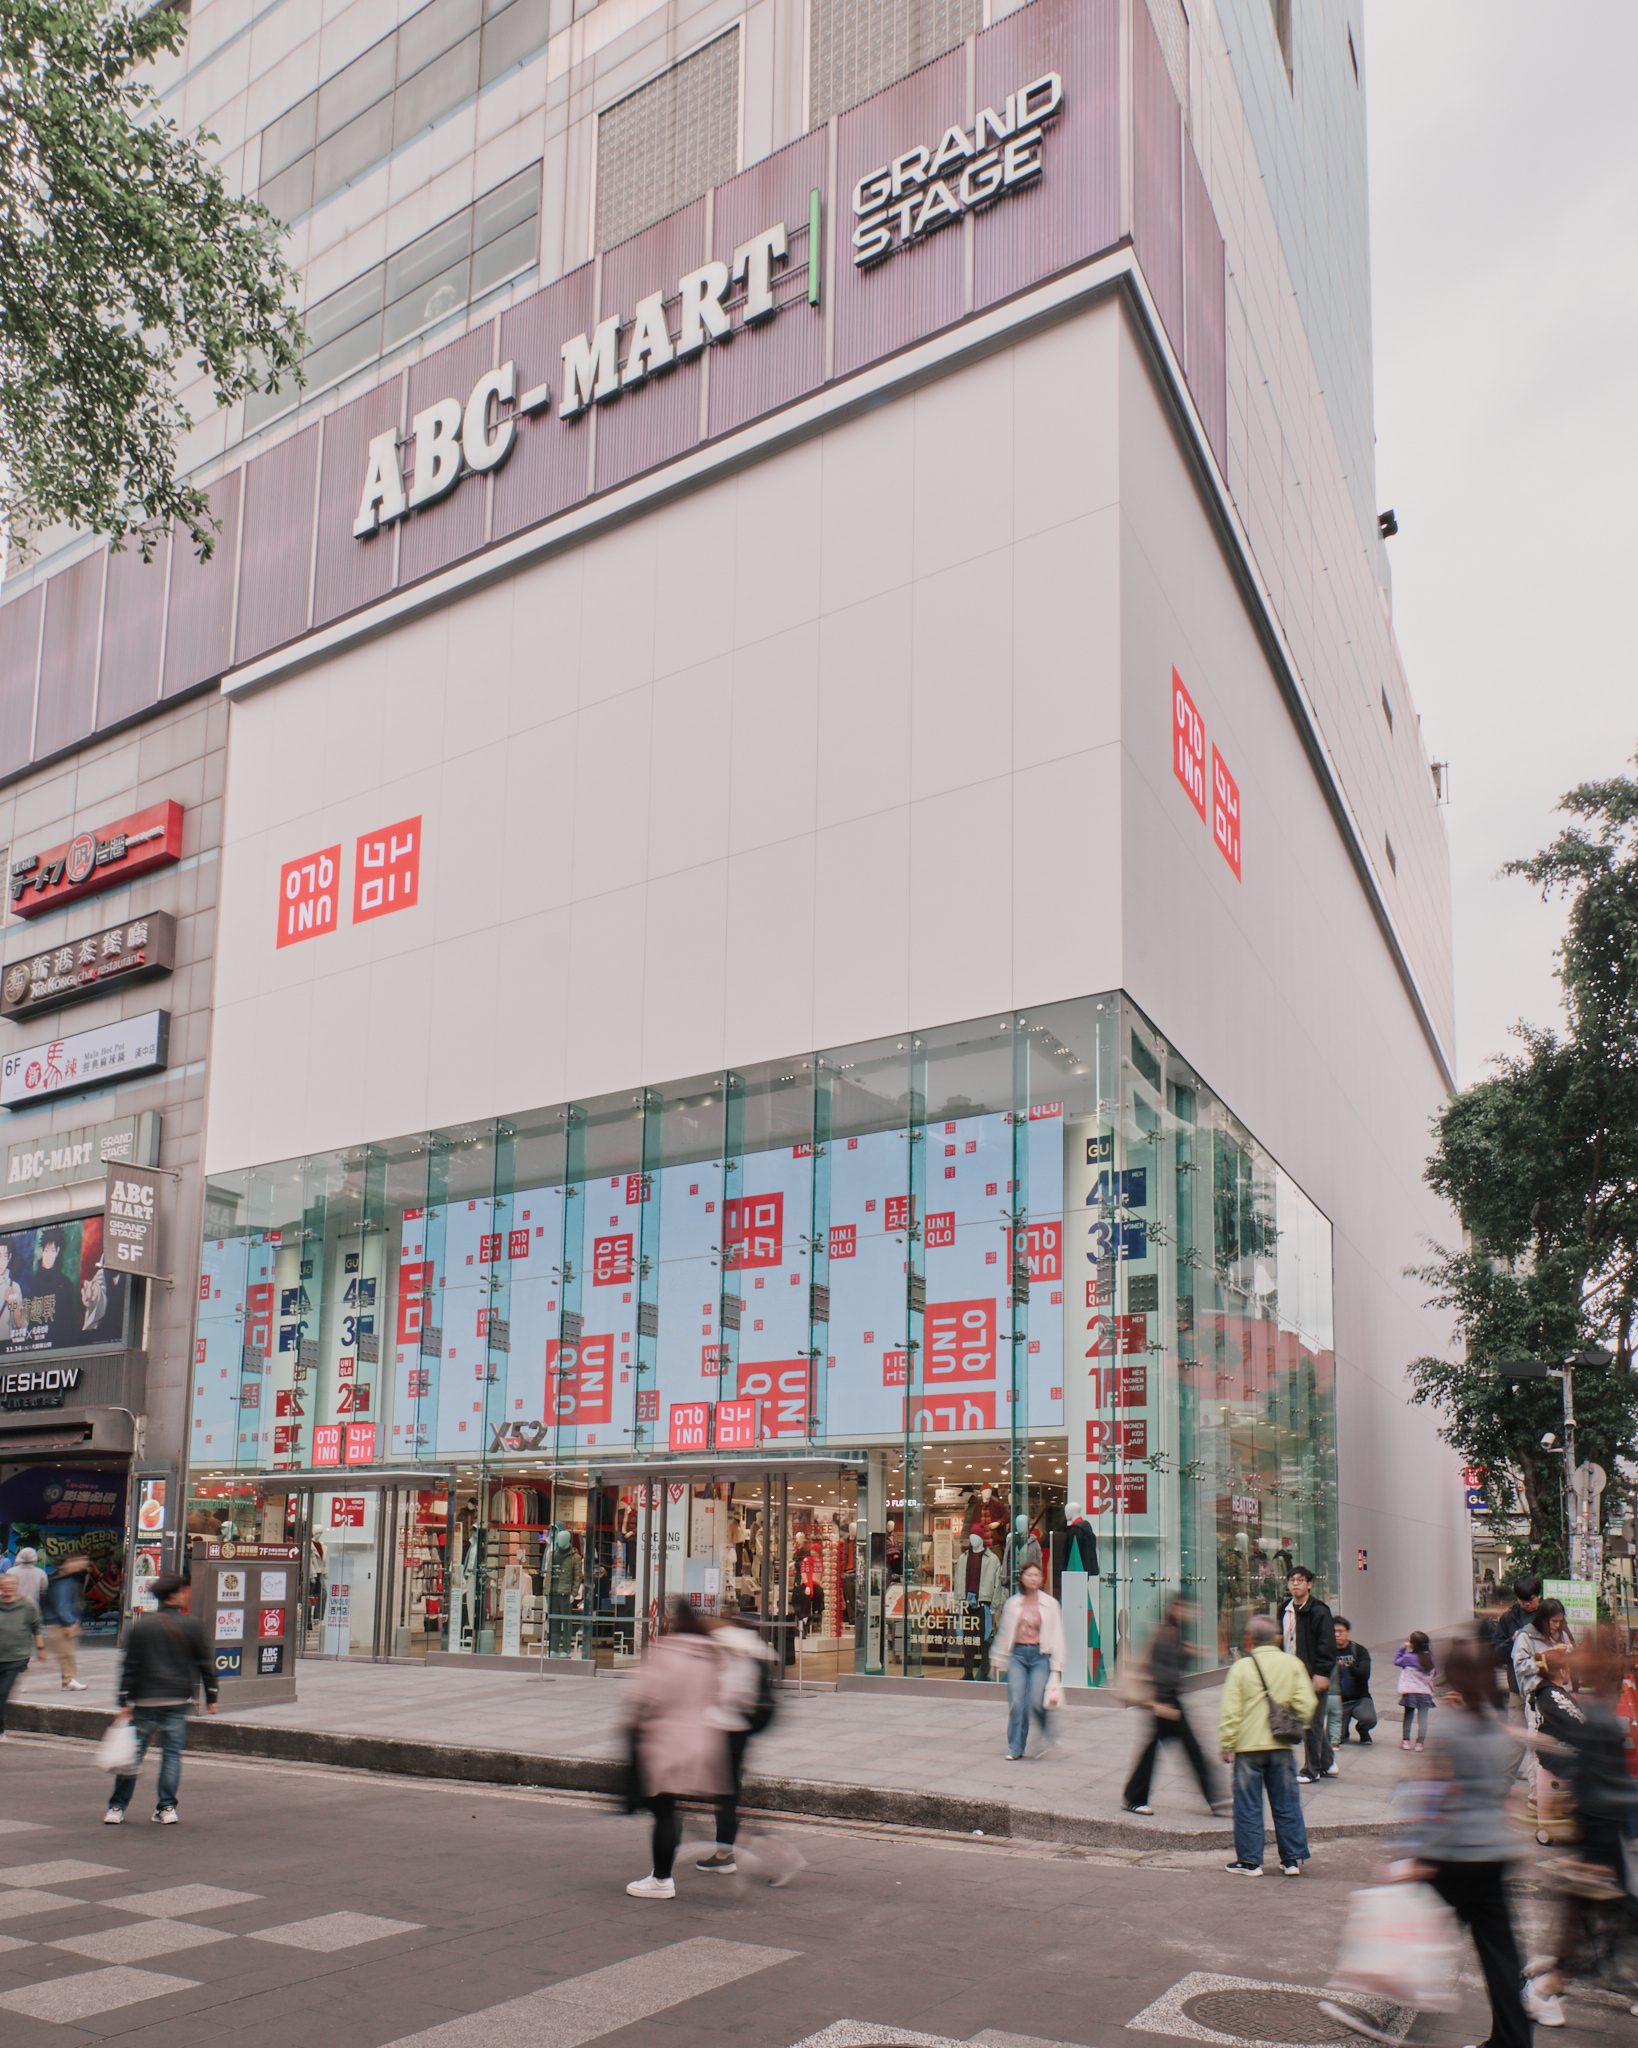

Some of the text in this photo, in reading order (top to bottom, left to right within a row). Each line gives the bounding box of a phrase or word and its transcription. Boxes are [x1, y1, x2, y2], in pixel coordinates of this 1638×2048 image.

[852, 71, 1062, 216] GRAND
[851, 126, 1043, 267] STAGE
[353, 221, 788, 540] ABC-MART
[286, 855, 333, 900] QLO
[288, 894, 332, 935] UNI
[5, 1057, 21, 1077] 6F
[100, 1132, 133, 1149] GRAND
[1088, 1143, 1109, 1158] GU
[8, 1142, 93, 1184] ABC-MART
[1131, 1170, 1144, 1179] MEN
[111, 1180, 153, 1206] ABC
[110, 1200, 153, 1221] MART
[109, 1220, 147, 1234] GRAND
[927, 1216, 950, 1230] UNI
[1123, 1222, 1144, 1231] WOMEN
[109, 1228, 144, 1241] STAGE
[830, 1229, 852, 1241] UNI
[927, 1230, 952, 1246] QLO
[117, 1243, 144, 1262] 5F
[612, 1239, 628, 1275] UNI
[830, 1242, 853, 1257] QLO
[345, 1258, 359, 1268] GU
[597, 1242, 612, 1280] QLO
[1131, 1316, 1144, 1324] MEN
[931, 1317, 957, 1375] UNI
[961, 1309, 992, 1372] QLO
[340, 1359, 352, 1367] UNI
[340, 1367, 353, 1376] QLO
[580, 1344, 606, 1408] UNI
[674, 1405, 704, 1426] QLO
[317, 1427, 339, 1445] QLO
[676, 1427, 703, 1445] UNI
[317, 1445, 338, 1461] UNI
[642, 1531, 681, 1543] OEING
[259, 1547, 269, 1556] 7F
[908, 1599, 970, 1614] WARMER
[910, 1615, 980, 1631] TOGETHER
[262, 1647, 278, 1657] ABC
[215, 1656, 240, 1670] GU
